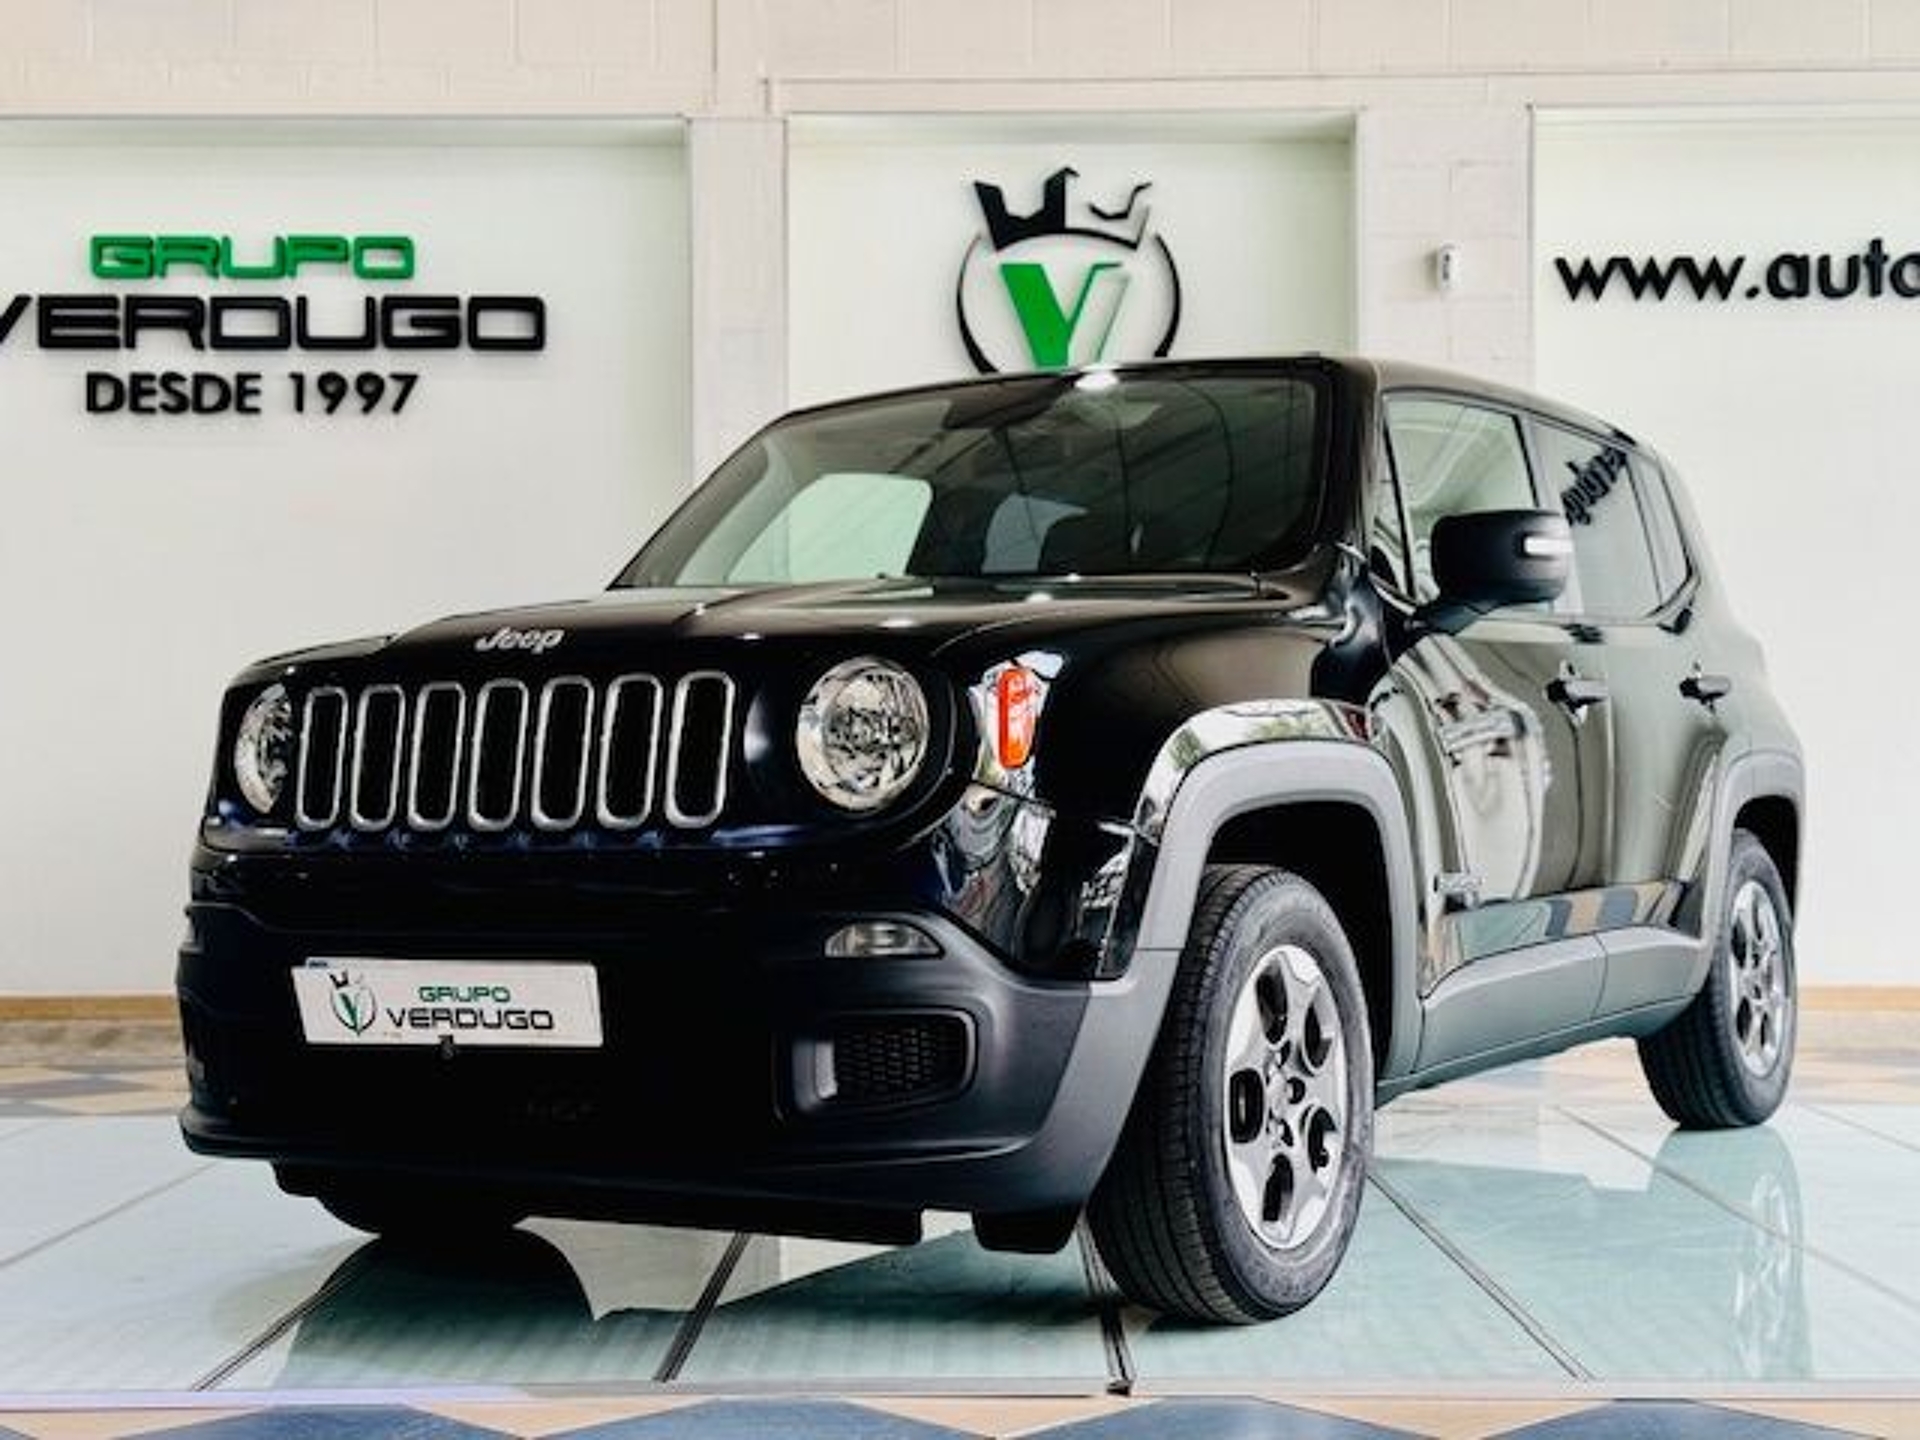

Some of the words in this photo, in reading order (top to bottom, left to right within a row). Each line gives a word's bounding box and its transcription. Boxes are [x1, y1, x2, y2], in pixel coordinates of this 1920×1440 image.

[91, 235, 415, 280] GRUPO
[1554, 237, 1920, 301] www.auto
[86, 371, 262, 414] DESDE
[289, 372, 418, 415] 1997
[475, 626, 565, 655] Jeep
[418, 985, 511, 1003] GRUPO
[386, 1007, 554, 1030] VERDUGO
